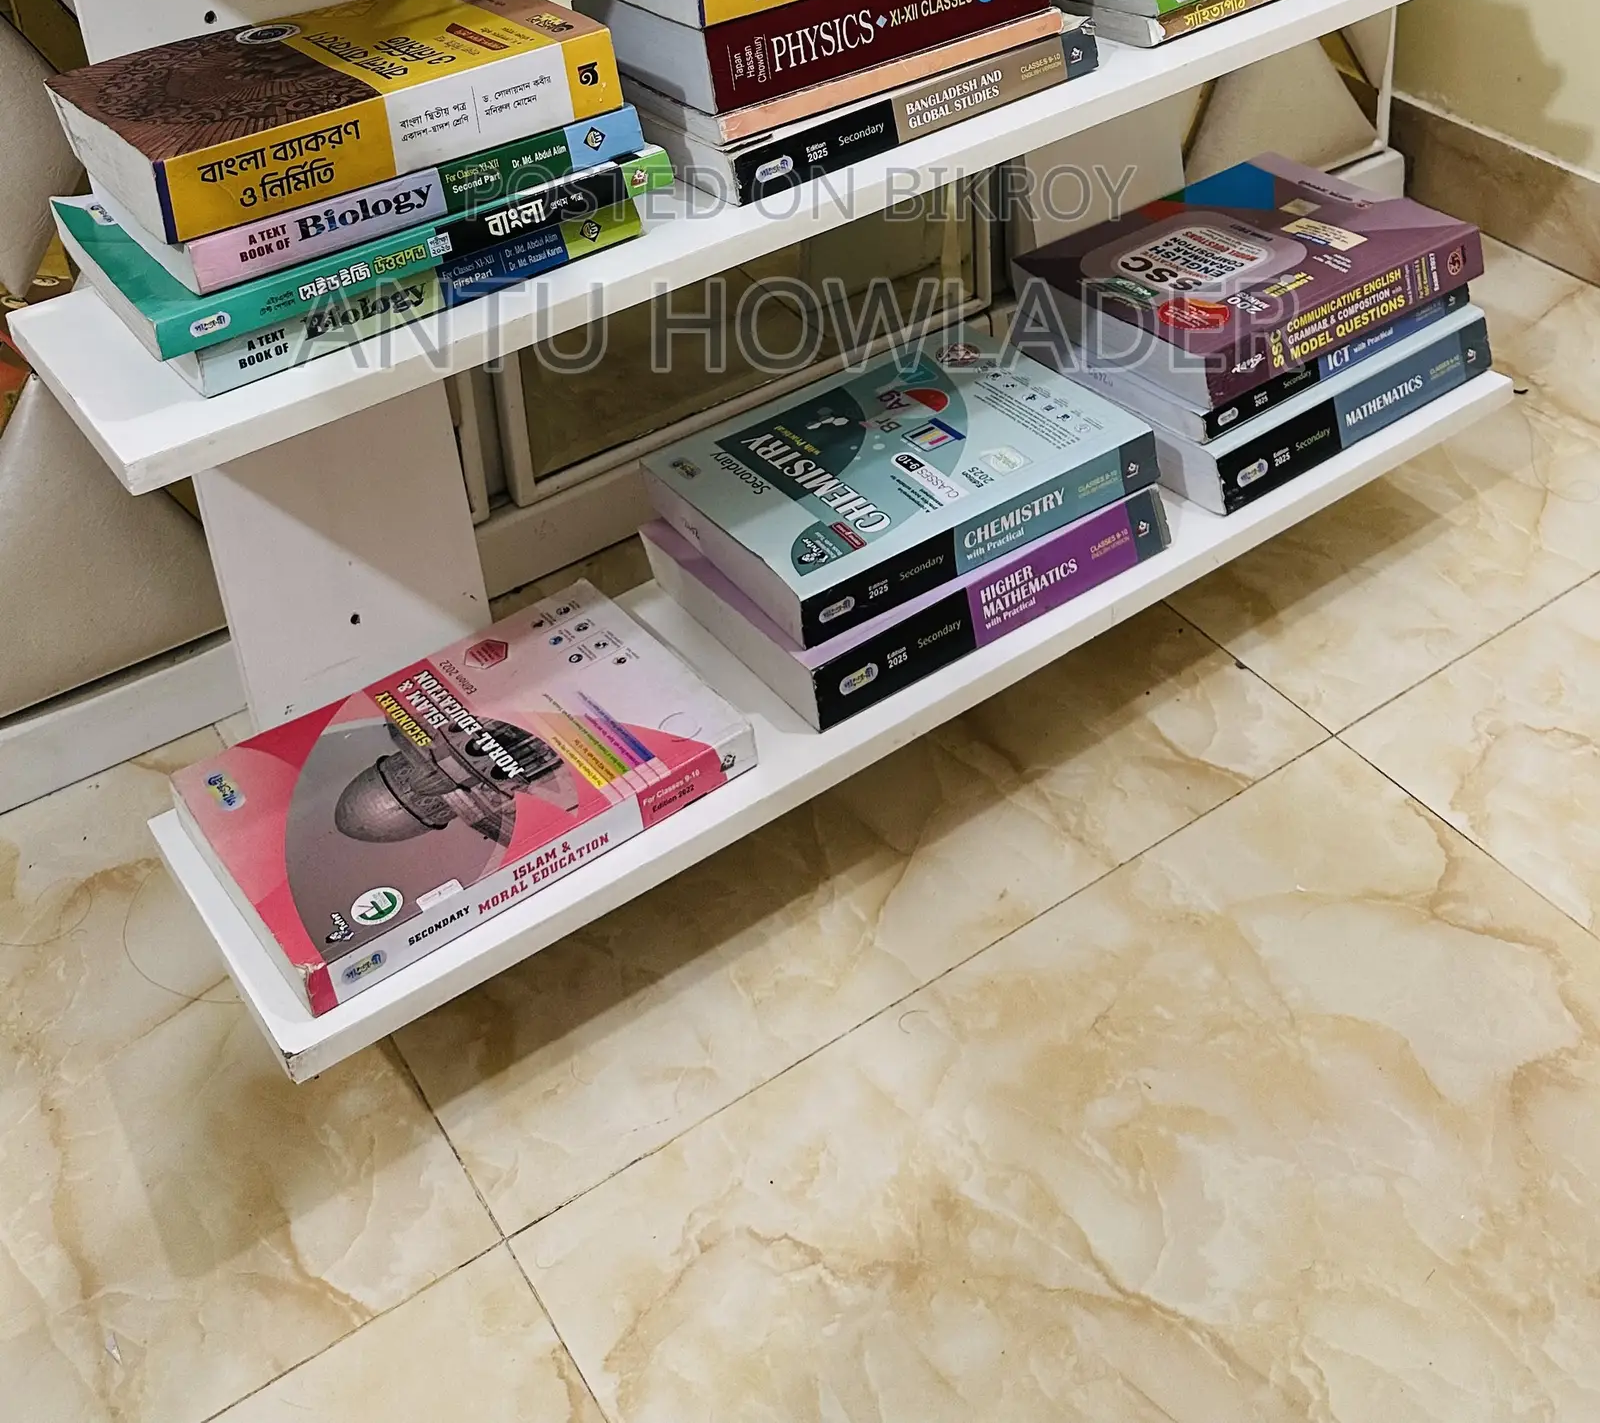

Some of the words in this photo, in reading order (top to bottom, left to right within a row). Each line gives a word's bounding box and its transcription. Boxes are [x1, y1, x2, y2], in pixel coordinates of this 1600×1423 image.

[771, 9, 874, 72] PHYSICS
[890, 5, 918, 27] XI-XII
[735, 52, 744, 80] Tapan
[746, 45, 755, 77] Hassan
[757, 36, 767, 83] Chowdhury
[484, 104, 511, 119] মনিরুল
[513, 94, 537, 111] মোমেন
[905, 78, 978, 115] BANGLADESH
[980, 69, 1002, 89] AND
[908, 107, 951, 129] GLOBAL
[954, 84, 1000, 113] STUDIES
[400, 115, 423, 130] বাংলা
[425, 105, 450, 125] দ্বিতীয়
[453, 101, 467, 113] পত্র
[838, 122, 884, 147] Secondary
[198, 148, 266, 184] বাংলা
[269, 120, 361, 162] ব্যাকরণ
[511, 158, 521, 169] Dr.
[521, 155, 533, 166] Md.
[534, 149, 552, 162] Abdul
[553, 144, 567, 156] Alim
[806, 142, 826, 153] Edition
[807, 148, 829, 163] 2025
[240, 186, 256, 209] ও
[259, 159, 334, 202] নির্মিতি
[452, 179, 483, 194] Second
[484, 172, 501, 186] Part
[294, 183, 432, 242] Biology
[485, 198, 547, 237] বাংলা
[550, 197, 569, 210] প্রথম
[570, 191, 584, 203] পত্র
[239, 243, 274, 263] BOOK
[275, 237, 291, 255] OF
[249, 234, 257, 245] A
[258, 224, 287, 242] TEXT
[452, 275, 473, 290] First
[474, 269, 493, 283] Part
[300, 282, 427, 341] Biology
[1287, 286, 1362, 332] COMMUNICATIVE
[1363, 268, 1402, 295] ENGLISH
[248, 338, 256, 352] A
[257, 328, 286, 348] TEXT
[1290, 334, 1333, 362] MODEL
[1336, 295, 1406, 338] QUESTIONS
[238, 349, 273, 370] BOOK
[274, 342, 290, 359] OF
[1270, 329, 1284, 368] SSC
[1326, 344, 1351, 371] ICT
[1353, 341, 1366, 353] with
[1367, 328, 1393, 347] Practical
[1283, 369, 1312, 389] Secondary
[1345, 375, 1423, 427] MATHEMATICS
[1295, 427, 1330, 451] Secondary
[711, 452, 771, 495] Secondary
[740, 434, 892, 533] CHEMISTRY
[964, 487, 1065, 550] CHEMISTRY
[966, 545, 985, 561] with
[987, 527, 1025, 550] Practical
[868, 579, 888, 592] Edition
[899, 554, 944, 581] Secondary
[980, 565, 1033, 603] HIGHER
[869, 584, 888, 600] 2025
[983, 558, 1078, 620] MATHEMATICS
[986, 615, 1001, 630] with
[1003, 596, 1037, 621] Practical
[887, 647, 907, 660] Edition
[918, 620, 961, 649] Secondary
[888, 652, 908, 669] 2025
[398, 679, 413, 692] &
[415, 670, 482, 735] EDUCATION
[375, 691, 433, 747] SECONDARY
[406, 690, 449, 728] ISLAM
[475, 731, 525, 778] MORAL
[478, 880, 528, 914] MORAL
[533, 833, 609, 883] EDUCATION
[513, 848, 557, 880] ISLAM
[562, 841, 571, 853] &
[409, 905, 470, 946] SECONDARY
